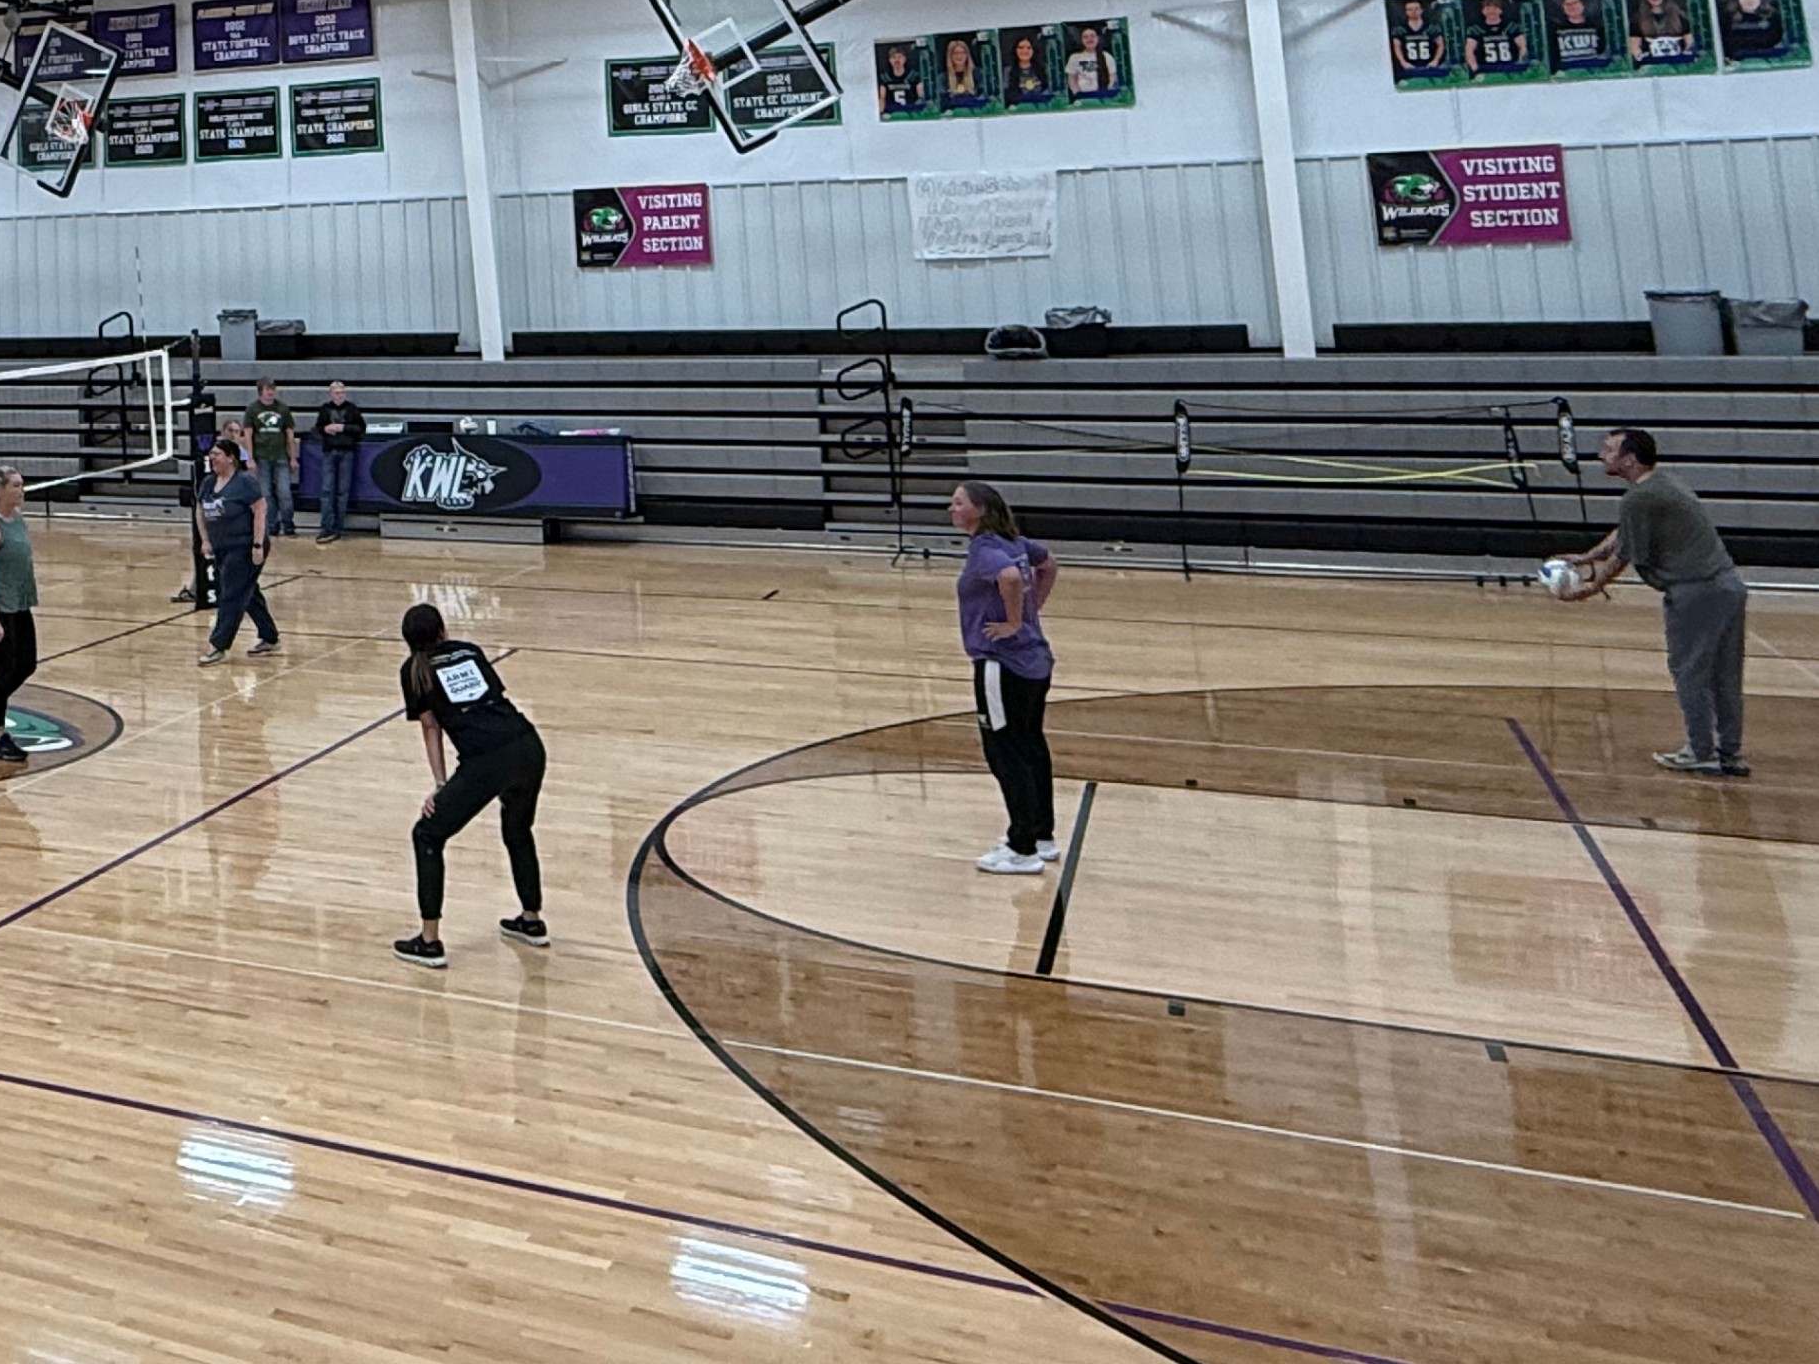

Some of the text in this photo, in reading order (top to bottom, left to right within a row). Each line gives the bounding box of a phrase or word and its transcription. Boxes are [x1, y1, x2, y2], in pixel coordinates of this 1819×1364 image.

[1461, 155, 1556, 176] VISITING
[637, 192, 702, 209] VISITING
[1463, 181, 1561, 203] STUDENT
[642, 214, 701, 231] PARENT
[1470, 208, 1559, 228] SECTION
[642, 236, 704, 253] SECTION
